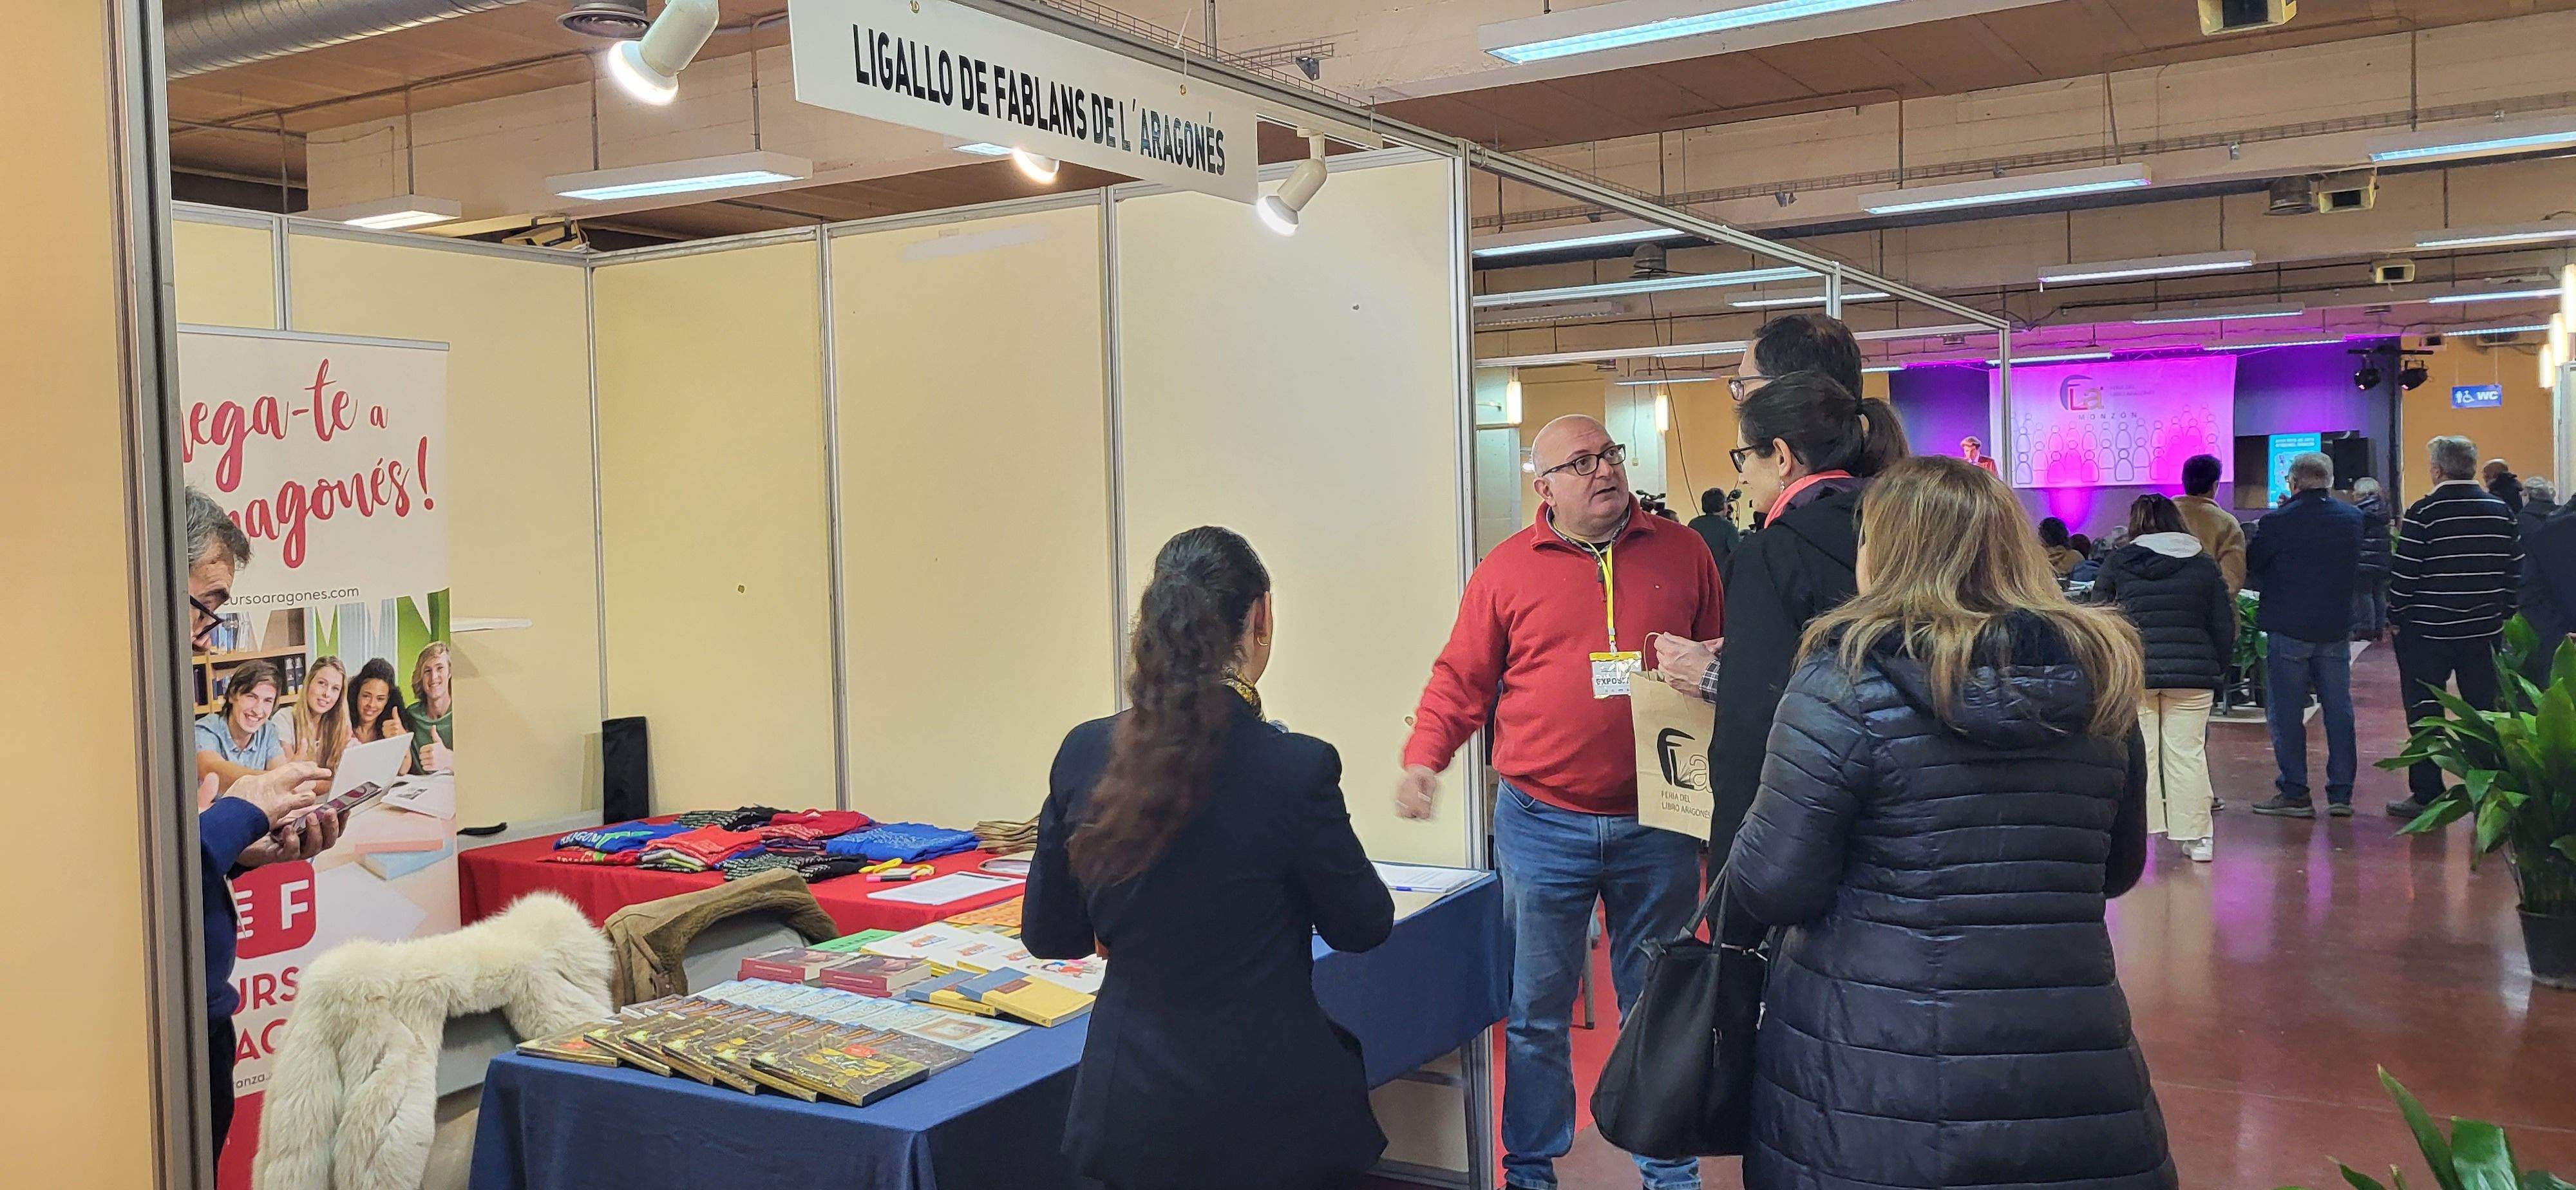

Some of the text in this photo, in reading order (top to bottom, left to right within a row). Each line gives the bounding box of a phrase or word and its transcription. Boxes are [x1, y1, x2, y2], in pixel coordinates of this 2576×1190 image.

[853, 24, 952, 107] LIGALLO
[959, 56, 989, 117] DE
[994, 64, 1086, 140] FABLANS
[1091, 92, 1116, 148] DE
[2477, 391, 2499, 401] WC
[370, 403, 388, 430] a
[1662, 790, 1690, 803] FERIA DEL
[1662, 802, 1680, 812] LIBRO
